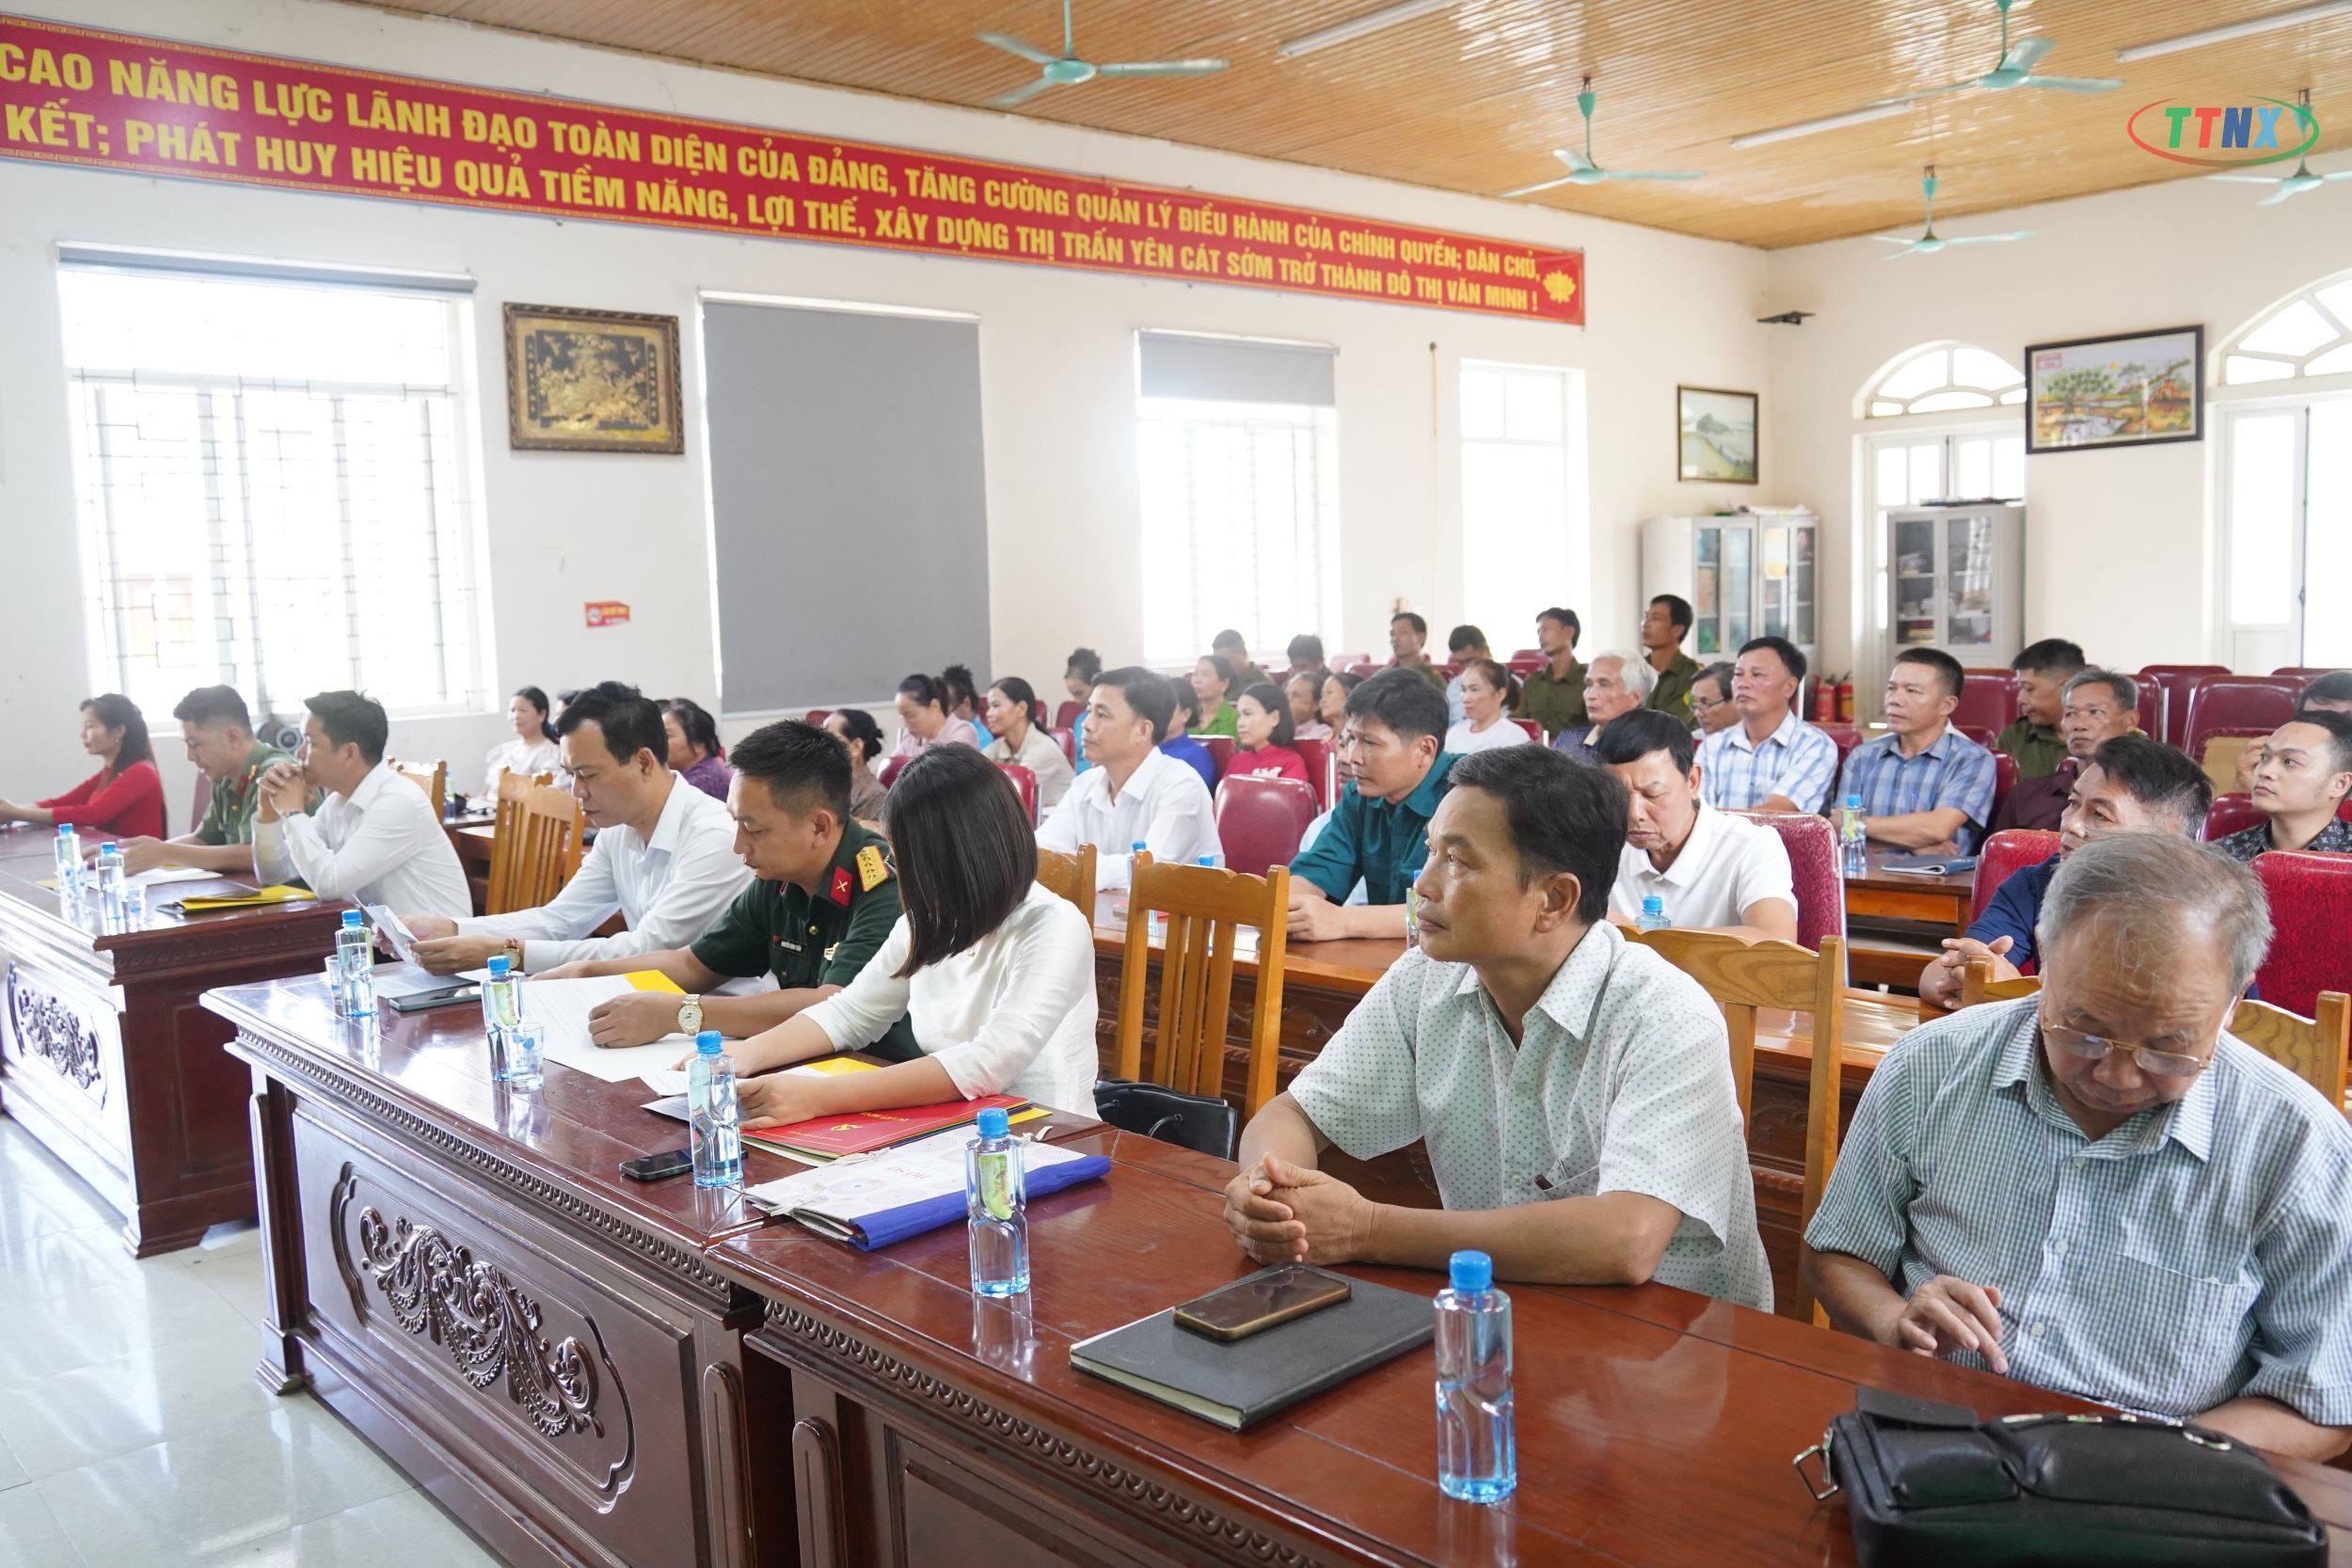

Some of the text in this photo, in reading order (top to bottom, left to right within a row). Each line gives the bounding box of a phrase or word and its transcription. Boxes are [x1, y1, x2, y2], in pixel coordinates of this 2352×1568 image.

[0, 42, 93, 91] CAO
[108, 57, 239, 111] NĂNG
[252, 80, 333, 127] LỰC
[345, 89, 451, 138] LÃNH
[461, 109, 538, 155] ĐẠO
[548, 119, 641, 163] TOÀN
[650, 133, 727, 176] DIỆN
[737, 137, 801, 182] CỦA
[807, 147, 898, 197] ĐẢNG,
[904, 166, 977, 204] TĂNG
[983, 177, 1070, 217] CƯỜNG
[1075, 187, 1140, 226] QUẢN
[1146, 199, 1172, 230] LÝ
[1178, 202, 1228, 238] ĐIỀU
[1232, 212, 1290, 245] HÀNH
[1294, 215, 1334, 252] CỦA
[1338, 229, 1396, 260] CHÍNH
[1466, 245, 1501, 276] DÂN
[6, 97, 1539, 313] KẾT; PHÁT HUY HIỆU QUẢ TIỀM NĂNG, LỢI THẾ, XÂY DỰNG THỊ TRẤN YÊN CÁT SỚM TRỞ THÀNH ĐÔ THỊ VĂN MINH !
